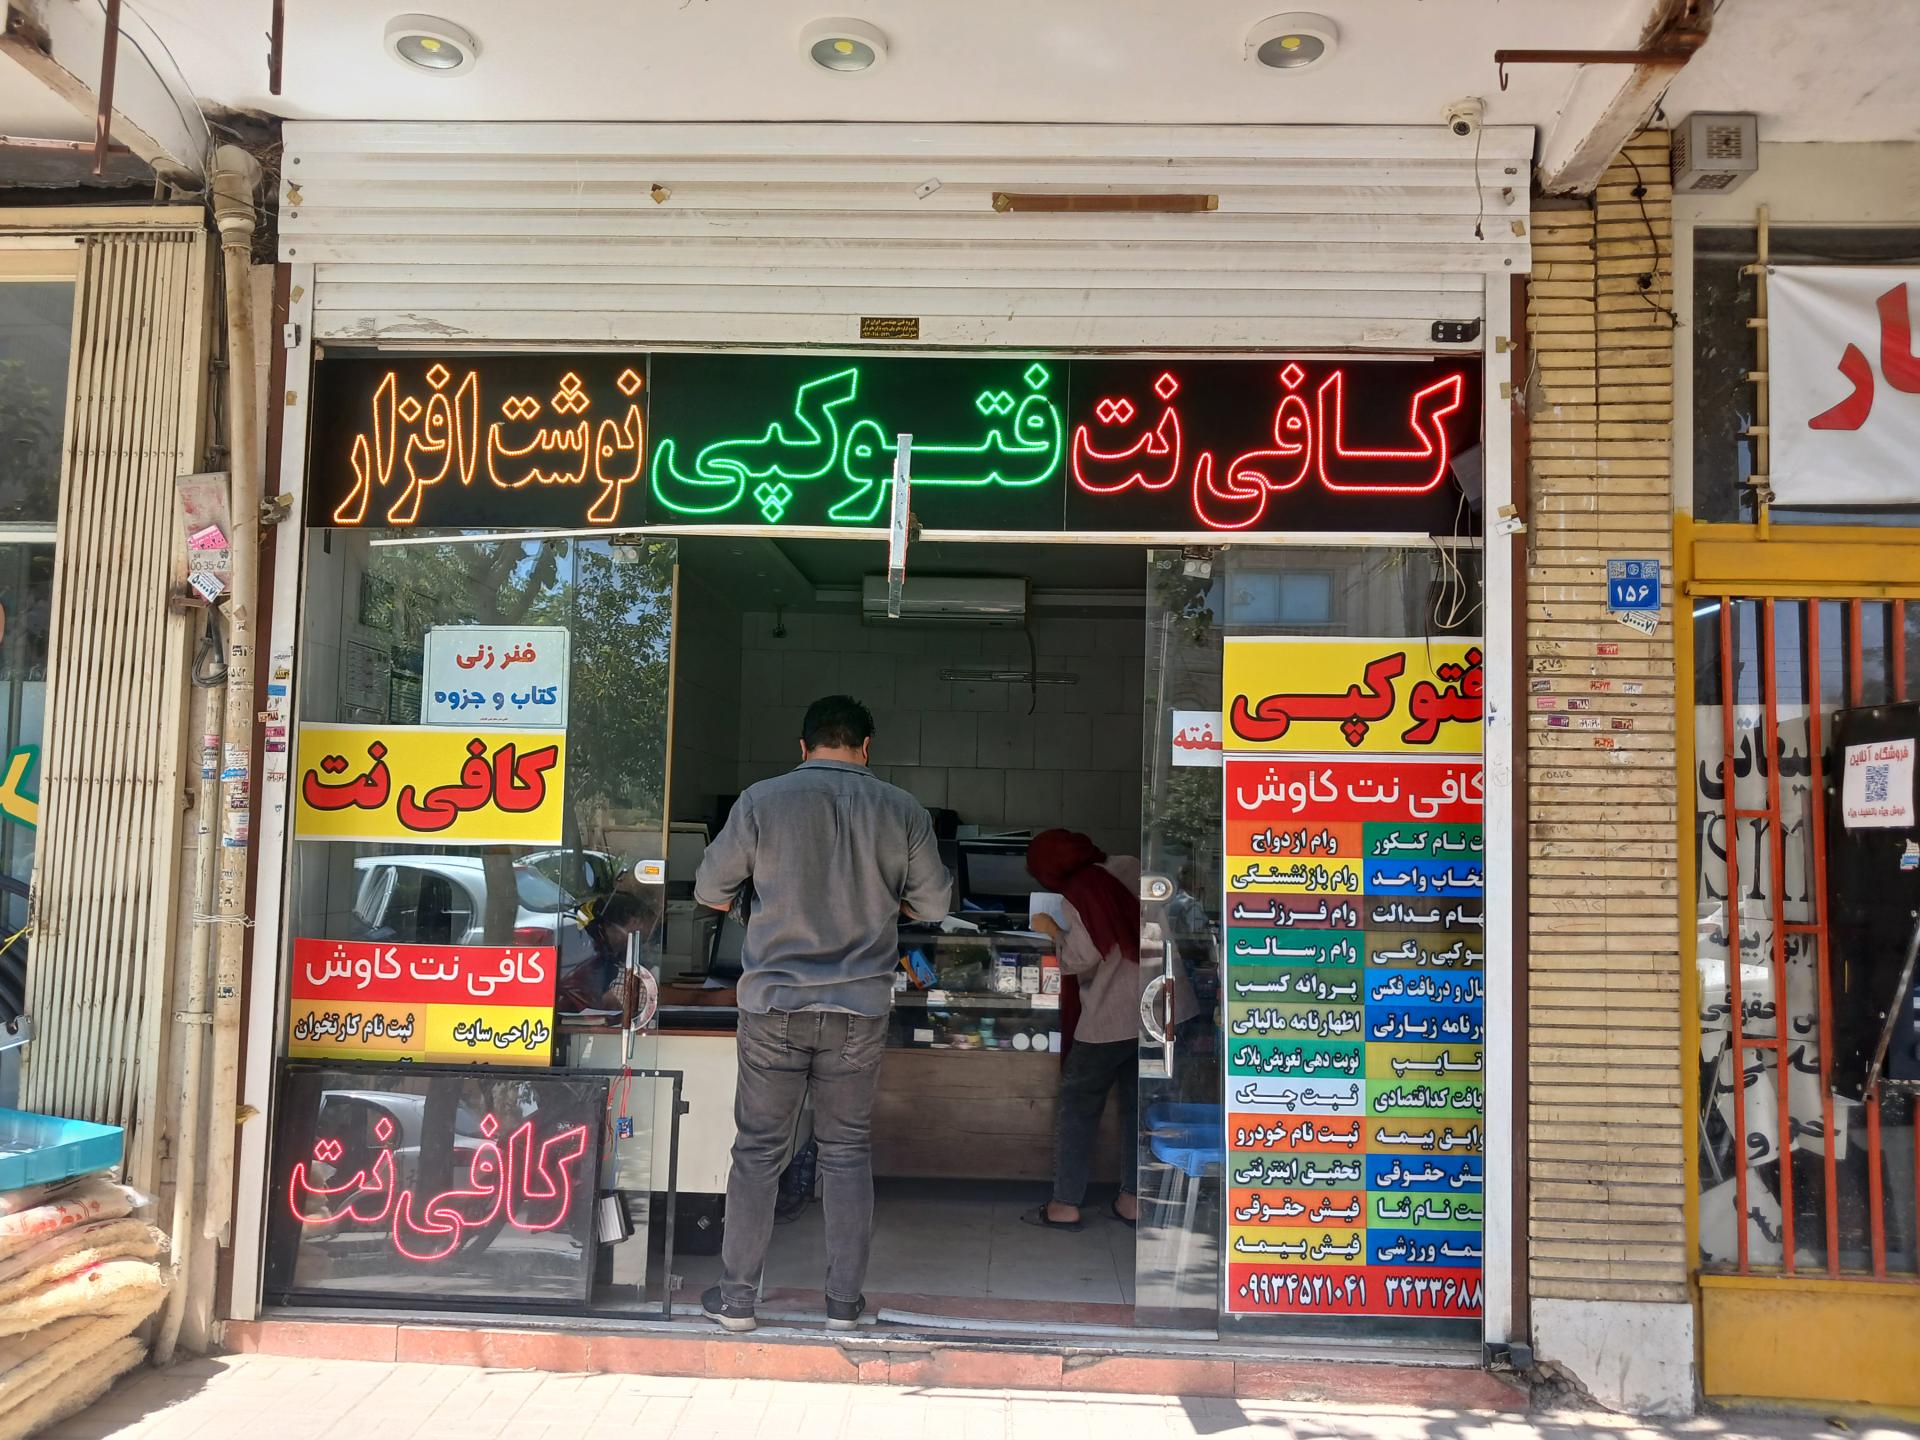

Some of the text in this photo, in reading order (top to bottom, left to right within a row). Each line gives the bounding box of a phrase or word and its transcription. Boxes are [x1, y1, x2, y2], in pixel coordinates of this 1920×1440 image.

[333, 362, 642, 524] نوشت افزار
[651, 362, 1062, 524] فتوکپی
[1072, 362, 1462, 529] کافی نت
[1617, 585, 1650, 602] ۱۵۶
[456, 642, 537, 670] فنر زنی
[434, 685, 558, 711] کتاب و جزوه
[1173, 722, 1223, 750] فته
[1875, 744, 1909, 763] فروشگاه
[302, 740, 391, 811] نت
[397, 737, 559, 832] کافی
[1236, 767, 1483, 819] کافی نت کاوش
[1251, 828, 1337, 856] وام ازدواج
[1371, 830, 1429, 856] کنکور
[1431, 830, 1466, 856] نام
[1231, 864, 1359, 892] وام بازنشستگی
[1371, 866, 1428, 893] واحد
[1233, 900, 1358, 928] وام فرزند
[1371, 902, 1441, 924] عدالت
[1233, 936, 1358, 964] وام رسالت
[1372, 937, 1427, 966] رنگی
[306, 944, 545, 997] کافی نت کاوش
[1234, 974, 1358, 1001] پروانه کسب
[1371, 975, 1405, 1001] فکس
[1406, 974, 1451, 1003] دریافت
[1453, 983, 1464, 1003] و
[294, 1012, 416, 1045] ثبت نام کارتخوان
[453, 1018, 550, 1050] طراحی سایت
[1232, 1008, 1361, 1037] اظهارنامه مالیاتی
[1373, 1013, 1438, 1040] زیارتی
[1233, 1046, 1361, 1075] نوبت دهی تعویض پلاک
[1391, 1049, 1483, 1078] تایپ
[1234, 1082, 1360, 1111] ثبت چک
[1235, 1121, 1360, 1149] ثبت نام خودرو
[1375, 1126, 1435, 1151] بیمه
[1234, 1157, 1362, 1185] تحقیق اینترنتی
[1375, 1160, 1445, 1187] حقوقی
[288, 1112, 588, 1261] کافی نت
[1234, 1194, 1361, 1223] فیش حقوقی
[1376, 1196, 1411, 1219] ثنا
[1413, 1198, 1451, 1226] نام
[1234, 1232, 1362, 1262] فیش بیمه
[1376, 1235, 1436, 1263] ورزشی
[1239, 1272, 1367, 1306] ۰۹۹۳۴۵۲۱۰۴۱
